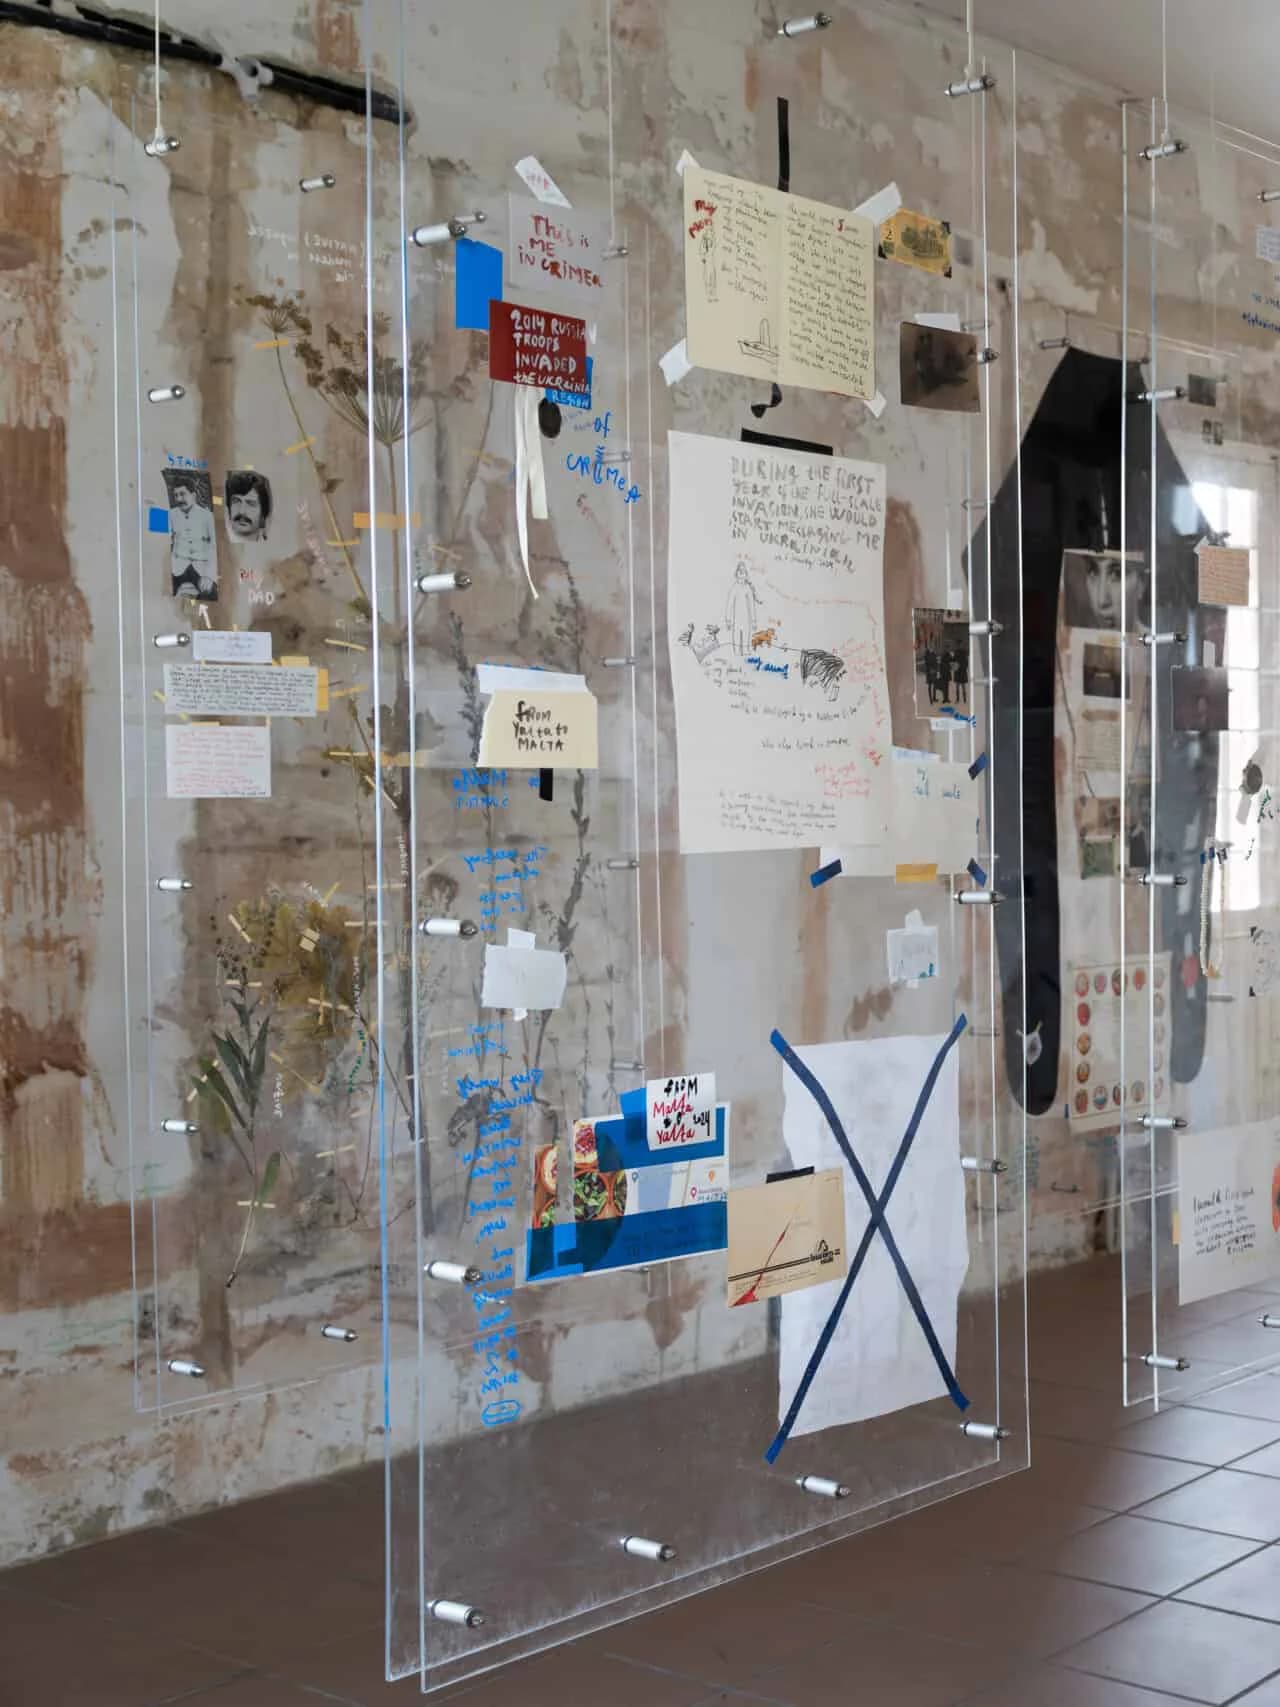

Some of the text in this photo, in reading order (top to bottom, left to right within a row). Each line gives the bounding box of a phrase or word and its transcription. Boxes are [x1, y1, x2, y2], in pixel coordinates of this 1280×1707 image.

[530, 214, 574, 247] This
[509, 309, 546, 332] 2014
[512, 332, 561, 352] TROOPS
[829, 502, 879, 529] WOULD
